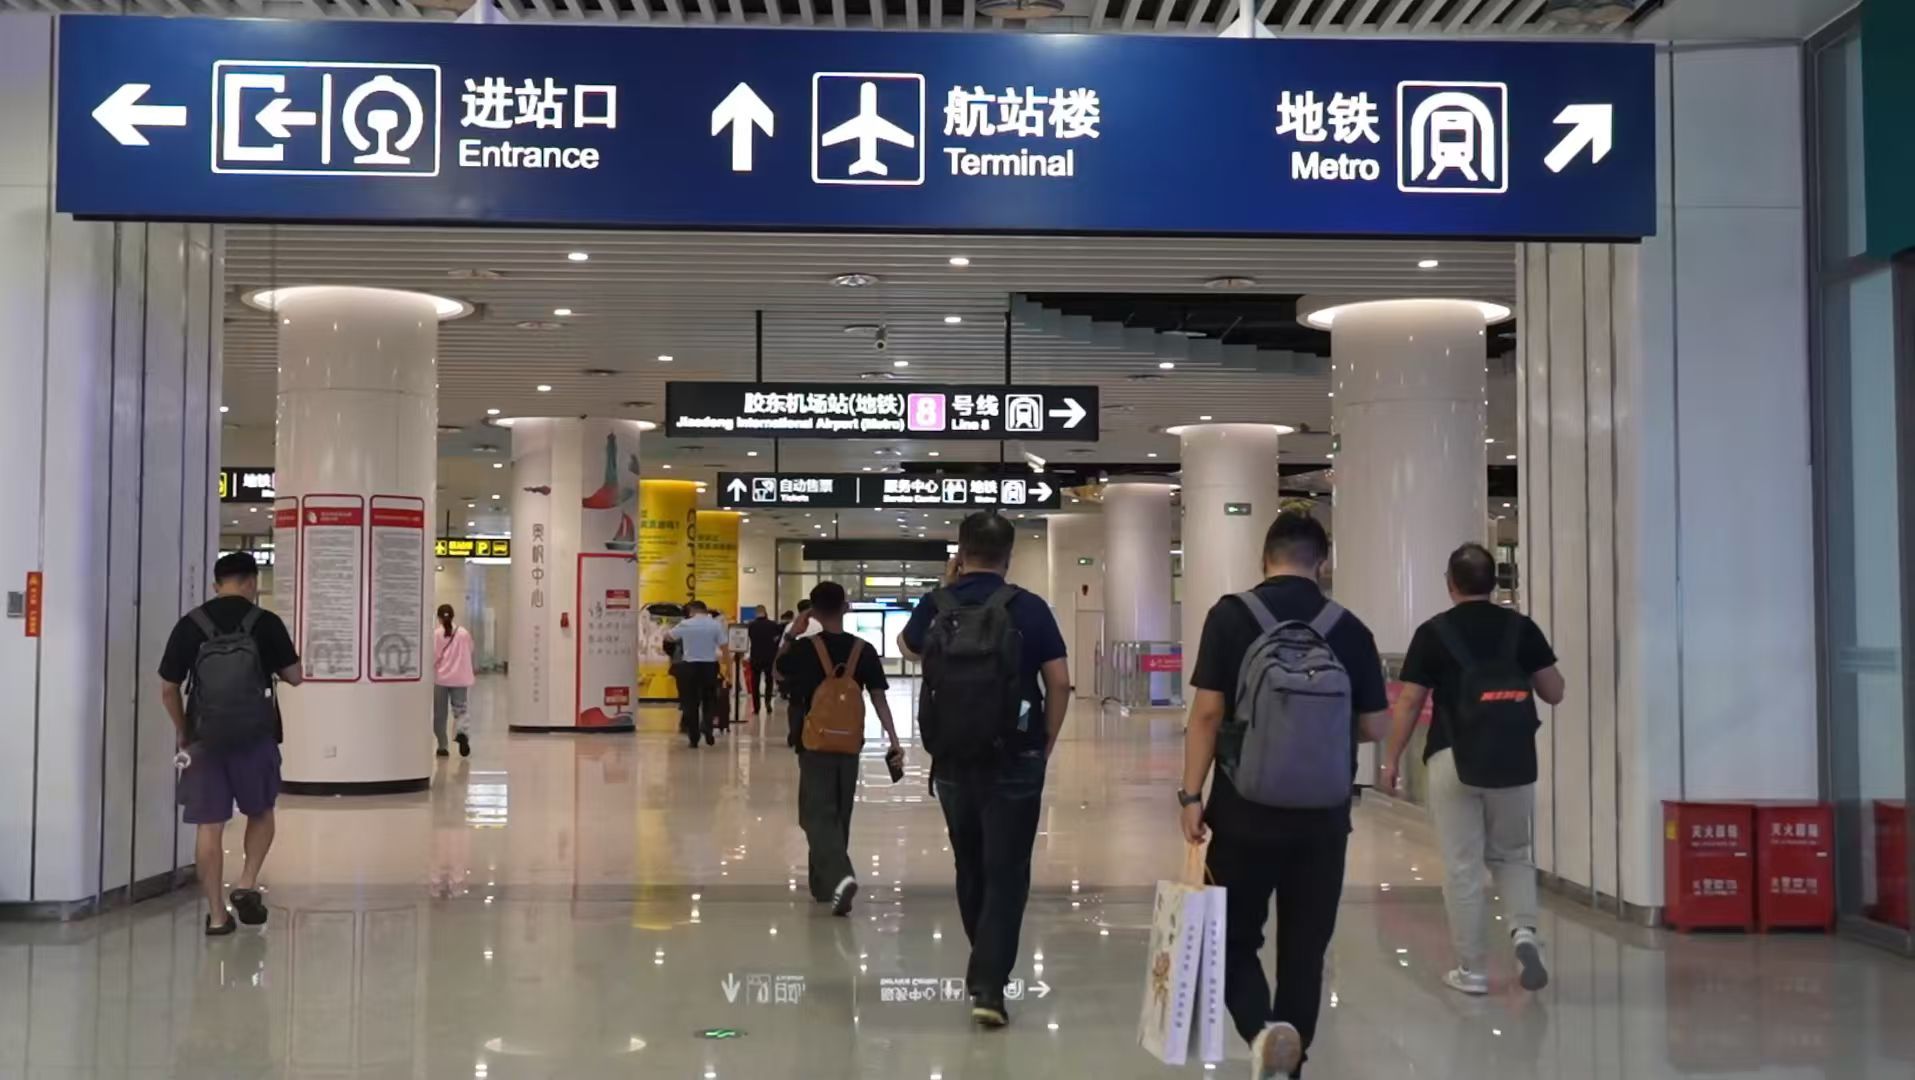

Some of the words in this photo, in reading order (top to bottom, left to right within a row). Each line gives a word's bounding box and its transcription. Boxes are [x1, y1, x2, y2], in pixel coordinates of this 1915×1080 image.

[461, 77, 616, 128] 进站口
[944, 86, 1099, 138] 航站楼
[1276, 91, 1380, 143] 地铁
[459, 139, 599, 169] Entrance
[944, 148, 1073, 176] Terminal
[1292, 152, 1379, 180] Metro
[917, 397, 937, 426] 8
[952, 395, 999, 416] 号线
